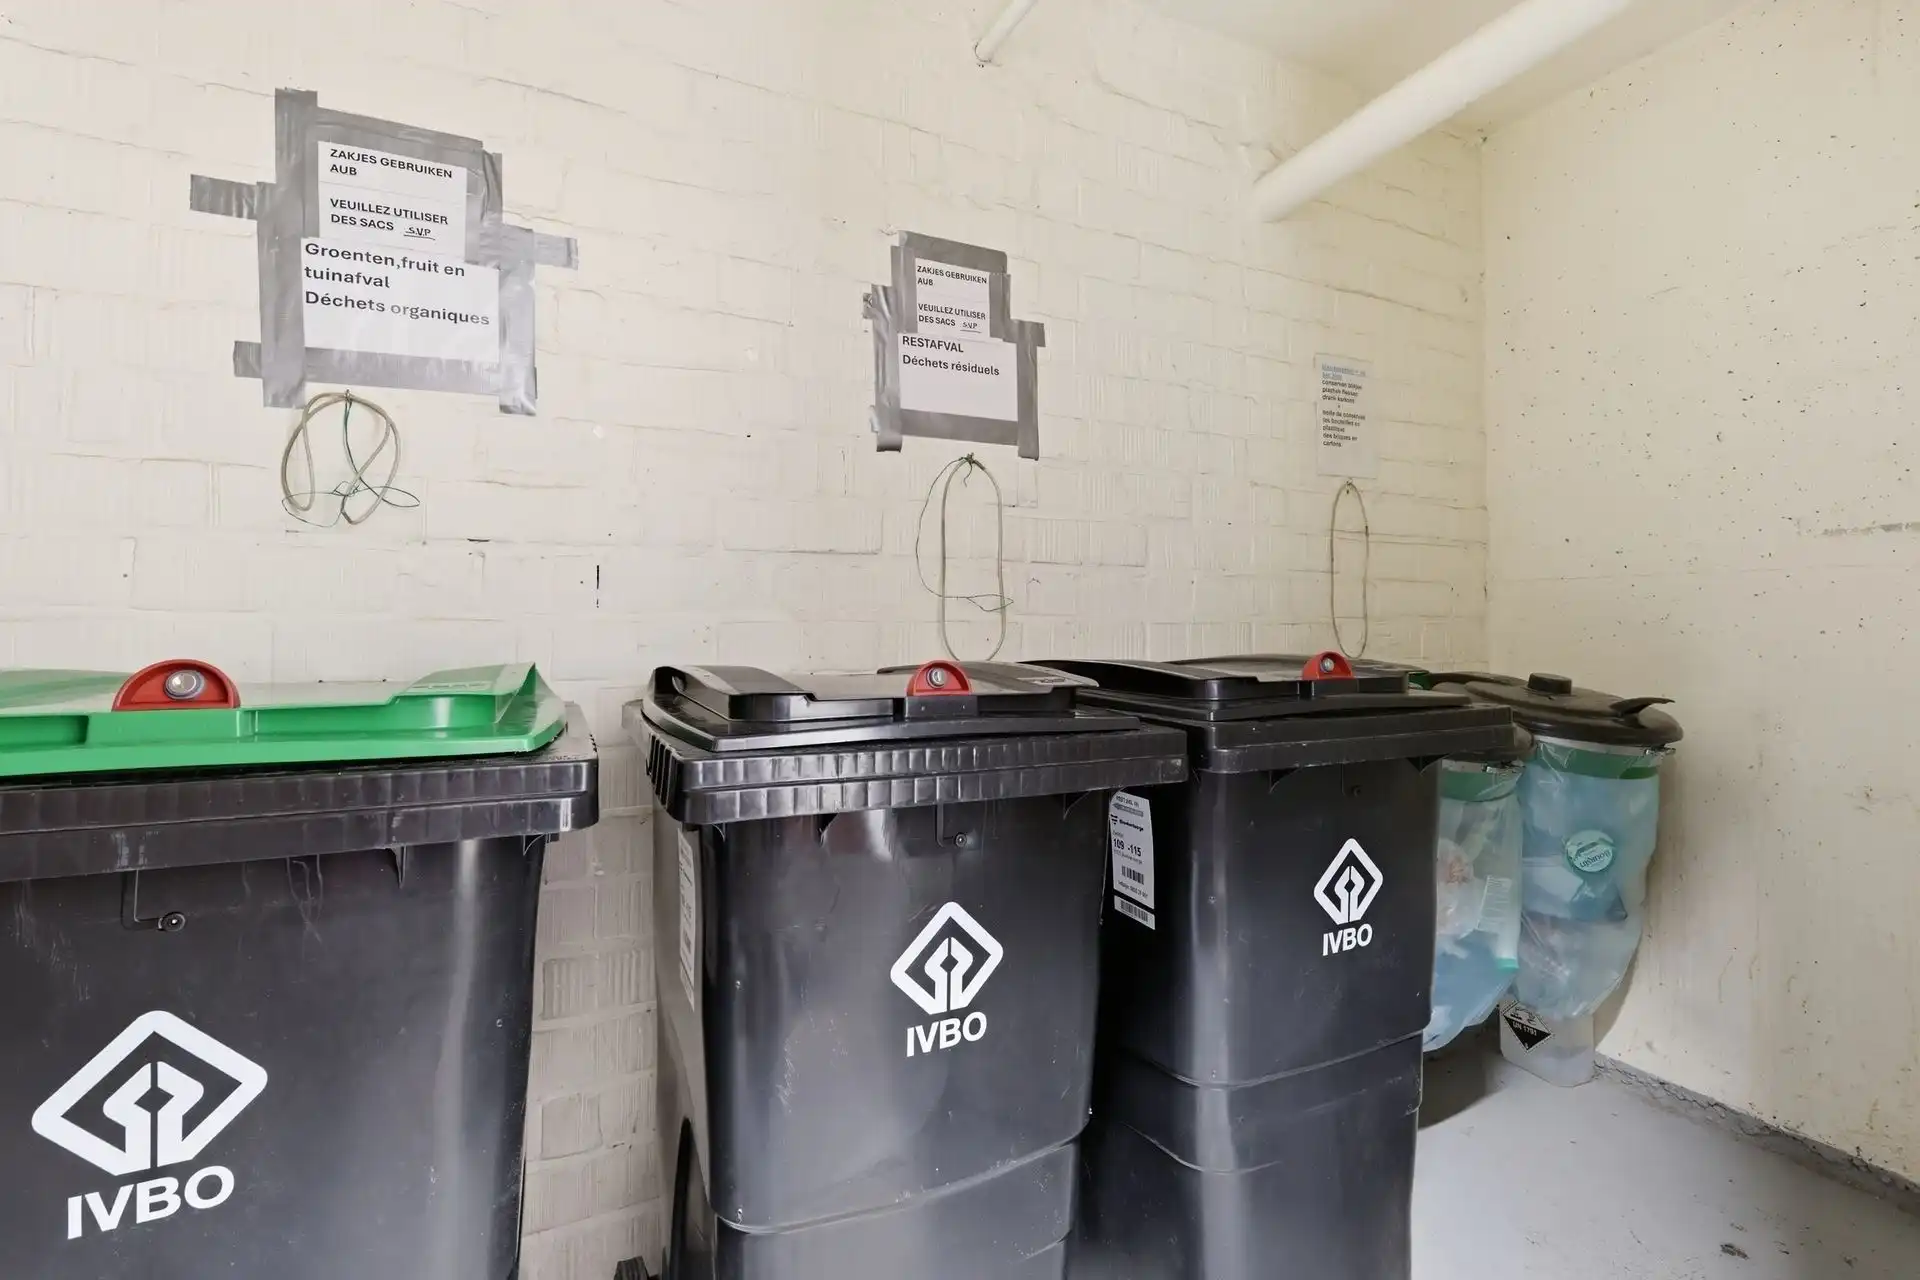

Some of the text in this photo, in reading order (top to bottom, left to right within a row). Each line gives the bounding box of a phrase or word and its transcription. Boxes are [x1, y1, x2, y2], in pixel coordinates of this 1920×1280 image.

[330, 148, 453, 179] ZAKJES GEBRUIKEN
[330, 164, 358, 176] AUB
[330, 198, 449, 225] VEUILLEZ UTILISER
[331, 214, 394, 232] DES SACS
[304, 266, 391, 289] tuinafval
[444, 264, 466, 277] en
[917, 265, 987, 285] ZAKJES GEBRUIKEN
[917, 277, 934, 287] AUB
[305, 291, 490, 326] Déchets organiques
[918, 303, 986, 321] VEUILLEZ UTILISER
[918, 315, 956, 327] DES SACS
[902, 336, 964, 353] RESTAFVAL
[903, 355, 1000, 376] Déchets résiduels
[1113, 838, 1125, 850] 109
[1322, 922, 1373, 957] IVBO
[906, 1010, 988, 1058] IVBO
[66, 1164, 236, 1240] IVBO
